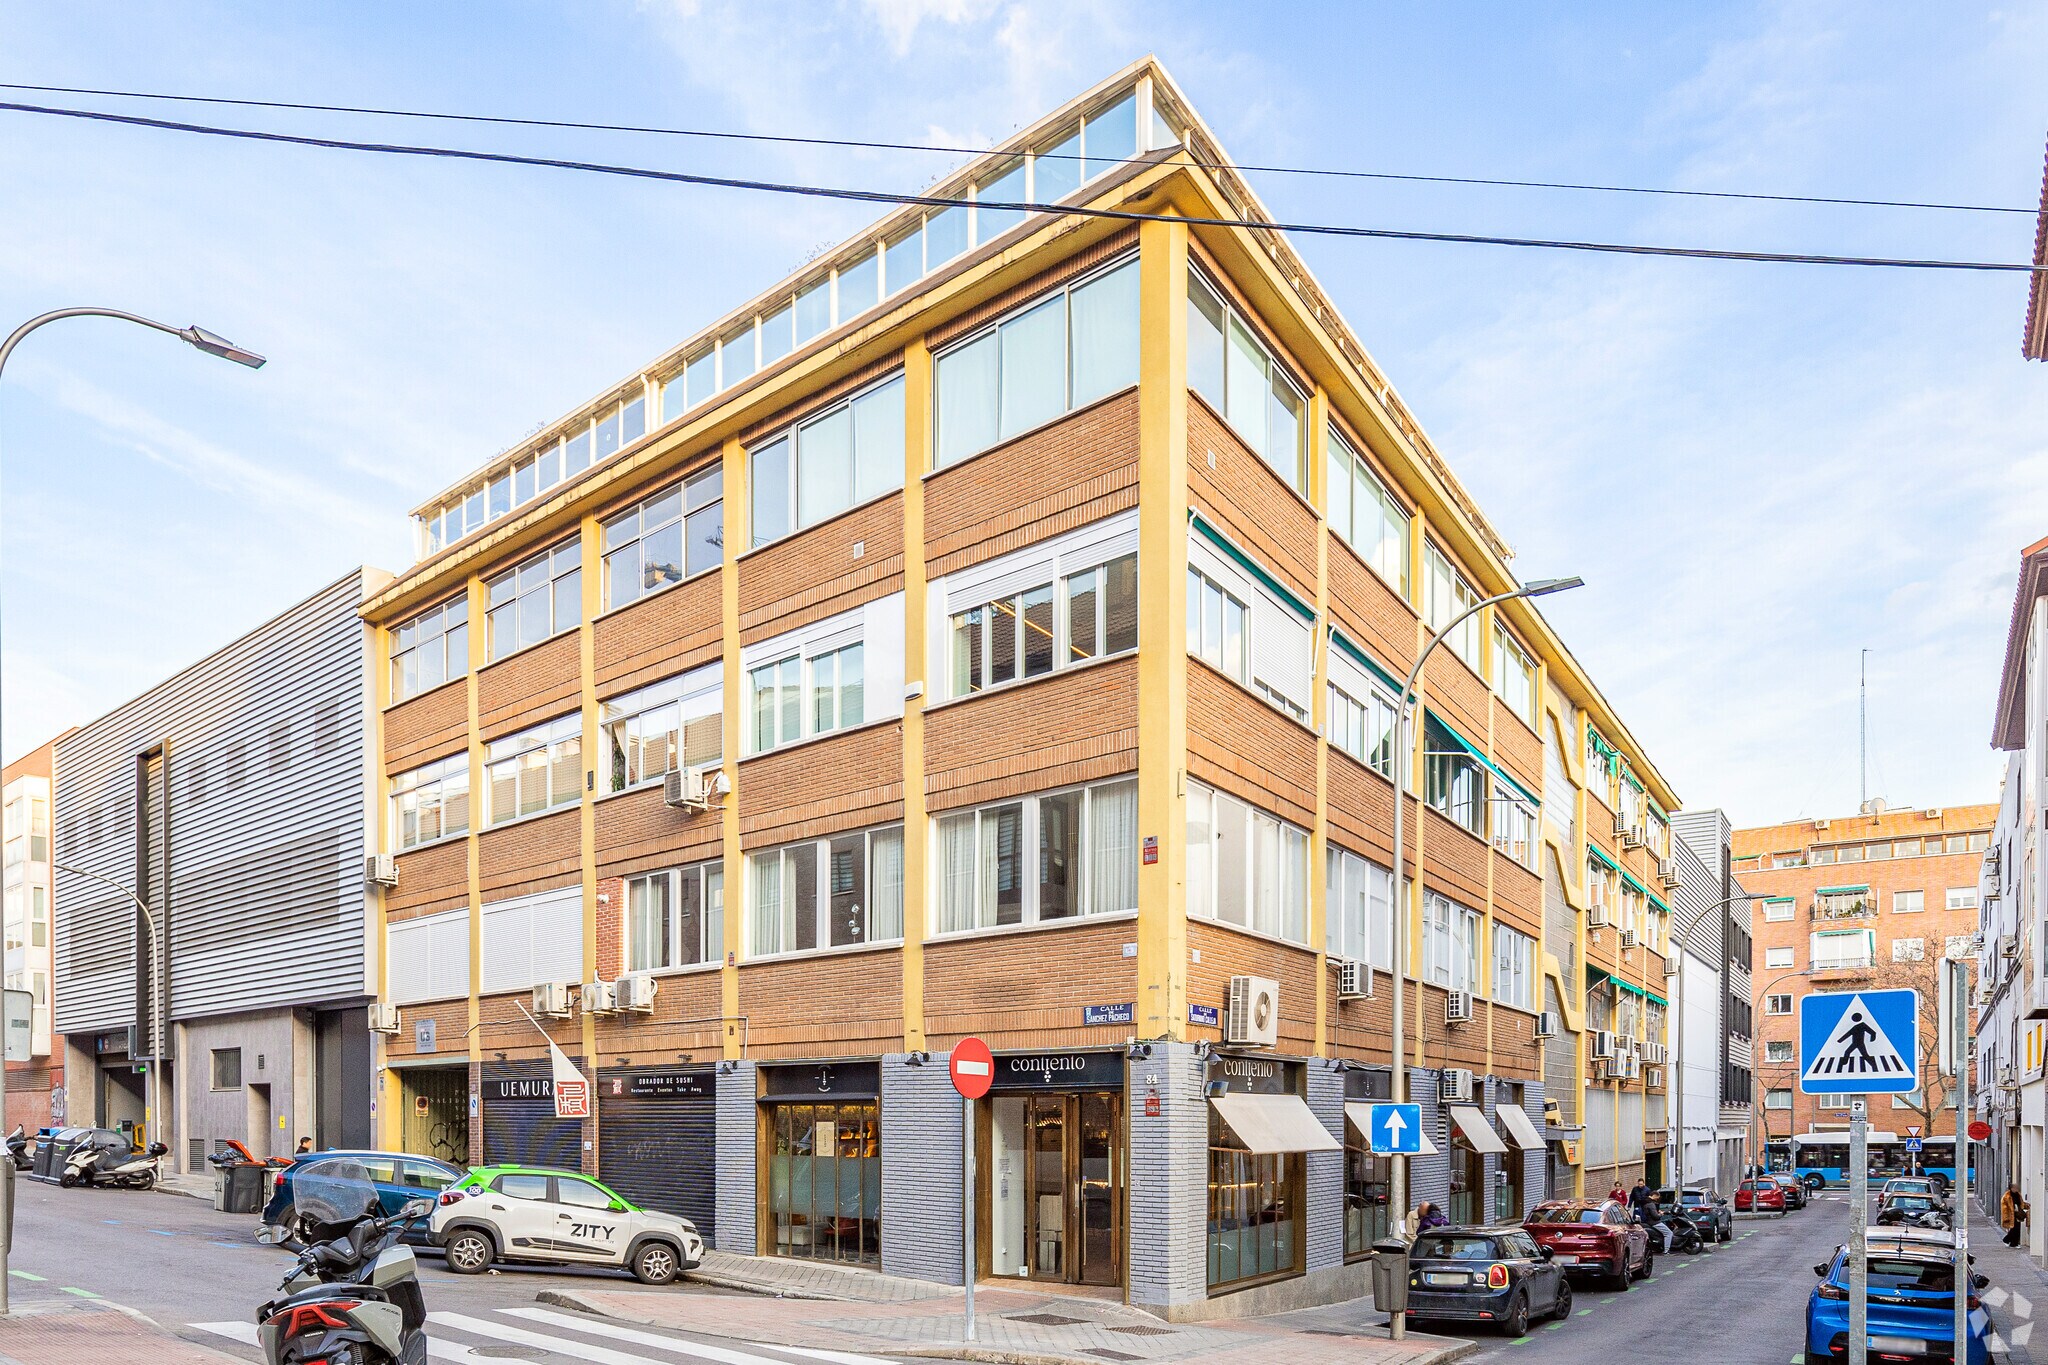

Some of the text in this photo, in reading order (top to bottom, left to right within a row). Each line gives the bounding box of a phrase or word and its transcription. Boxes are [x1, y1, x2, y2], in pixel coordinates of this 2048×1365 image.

[1198, 1006, 1213, 1014] CALLE
[1108, 1013, 1130, 1021] PACHECO
[638, 1077, 664, 1085] OBRADOR
[1146, 1074, 1158, 1084] 84
[500, 1081, 555, 1097] UEMUR
[571, 1223, 616, 1240] ZITY
